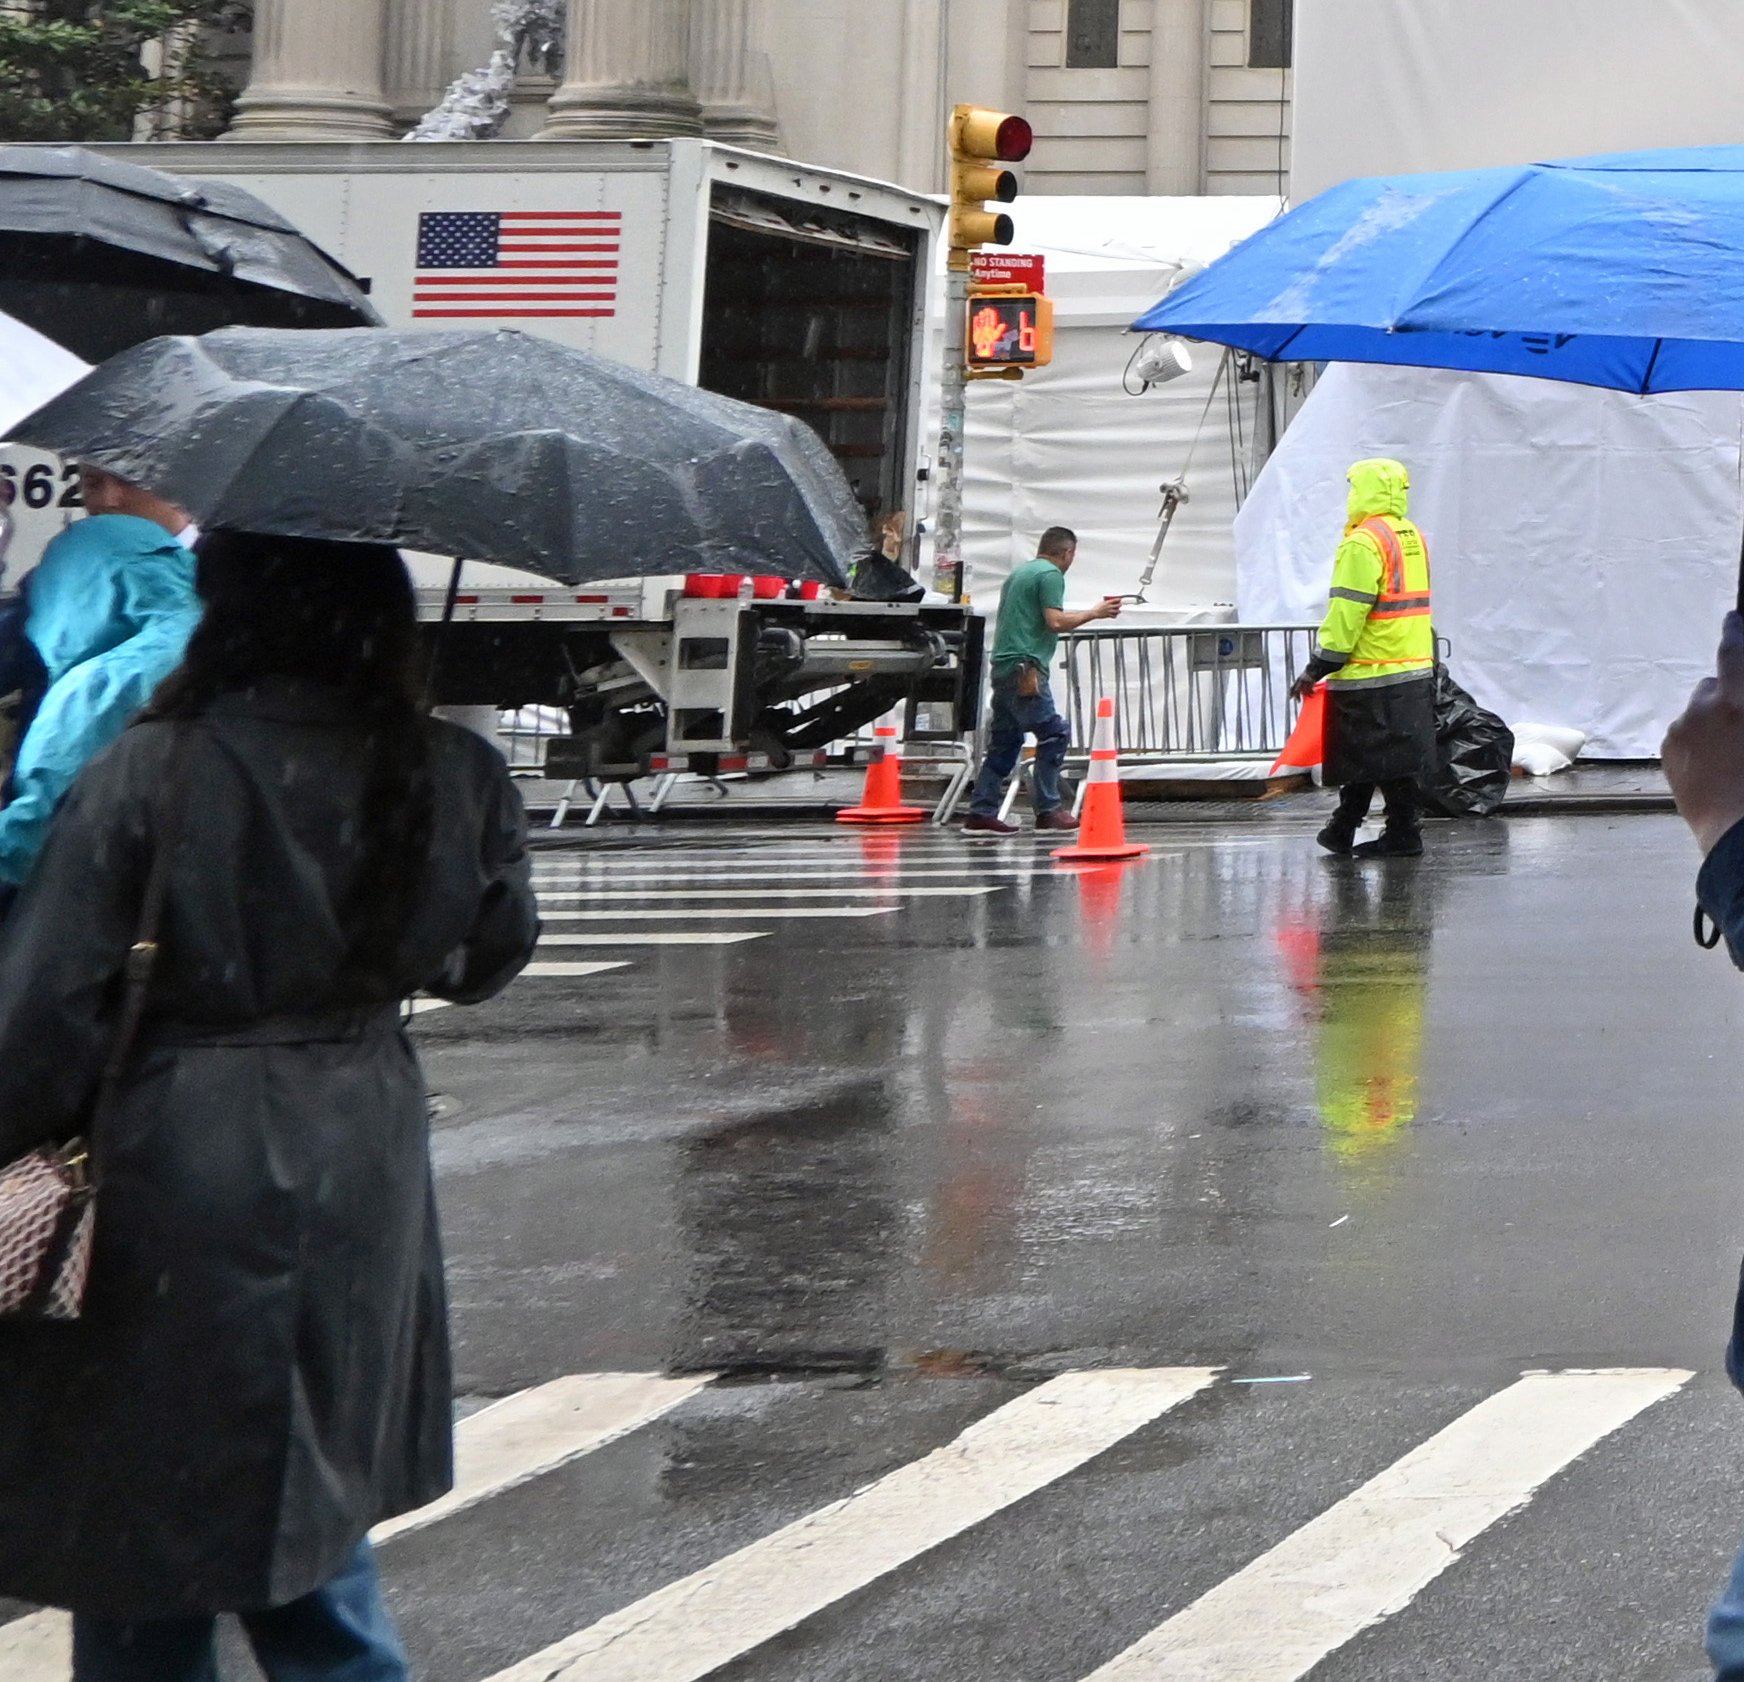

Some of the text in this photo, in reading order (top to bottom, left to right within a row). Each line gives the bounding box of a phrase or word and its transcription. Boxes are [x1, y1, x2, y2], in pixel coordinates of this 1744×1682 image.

[973, 257, 1033, 268] NO STANDING
[974, 268, 1012, 280] Anytime
